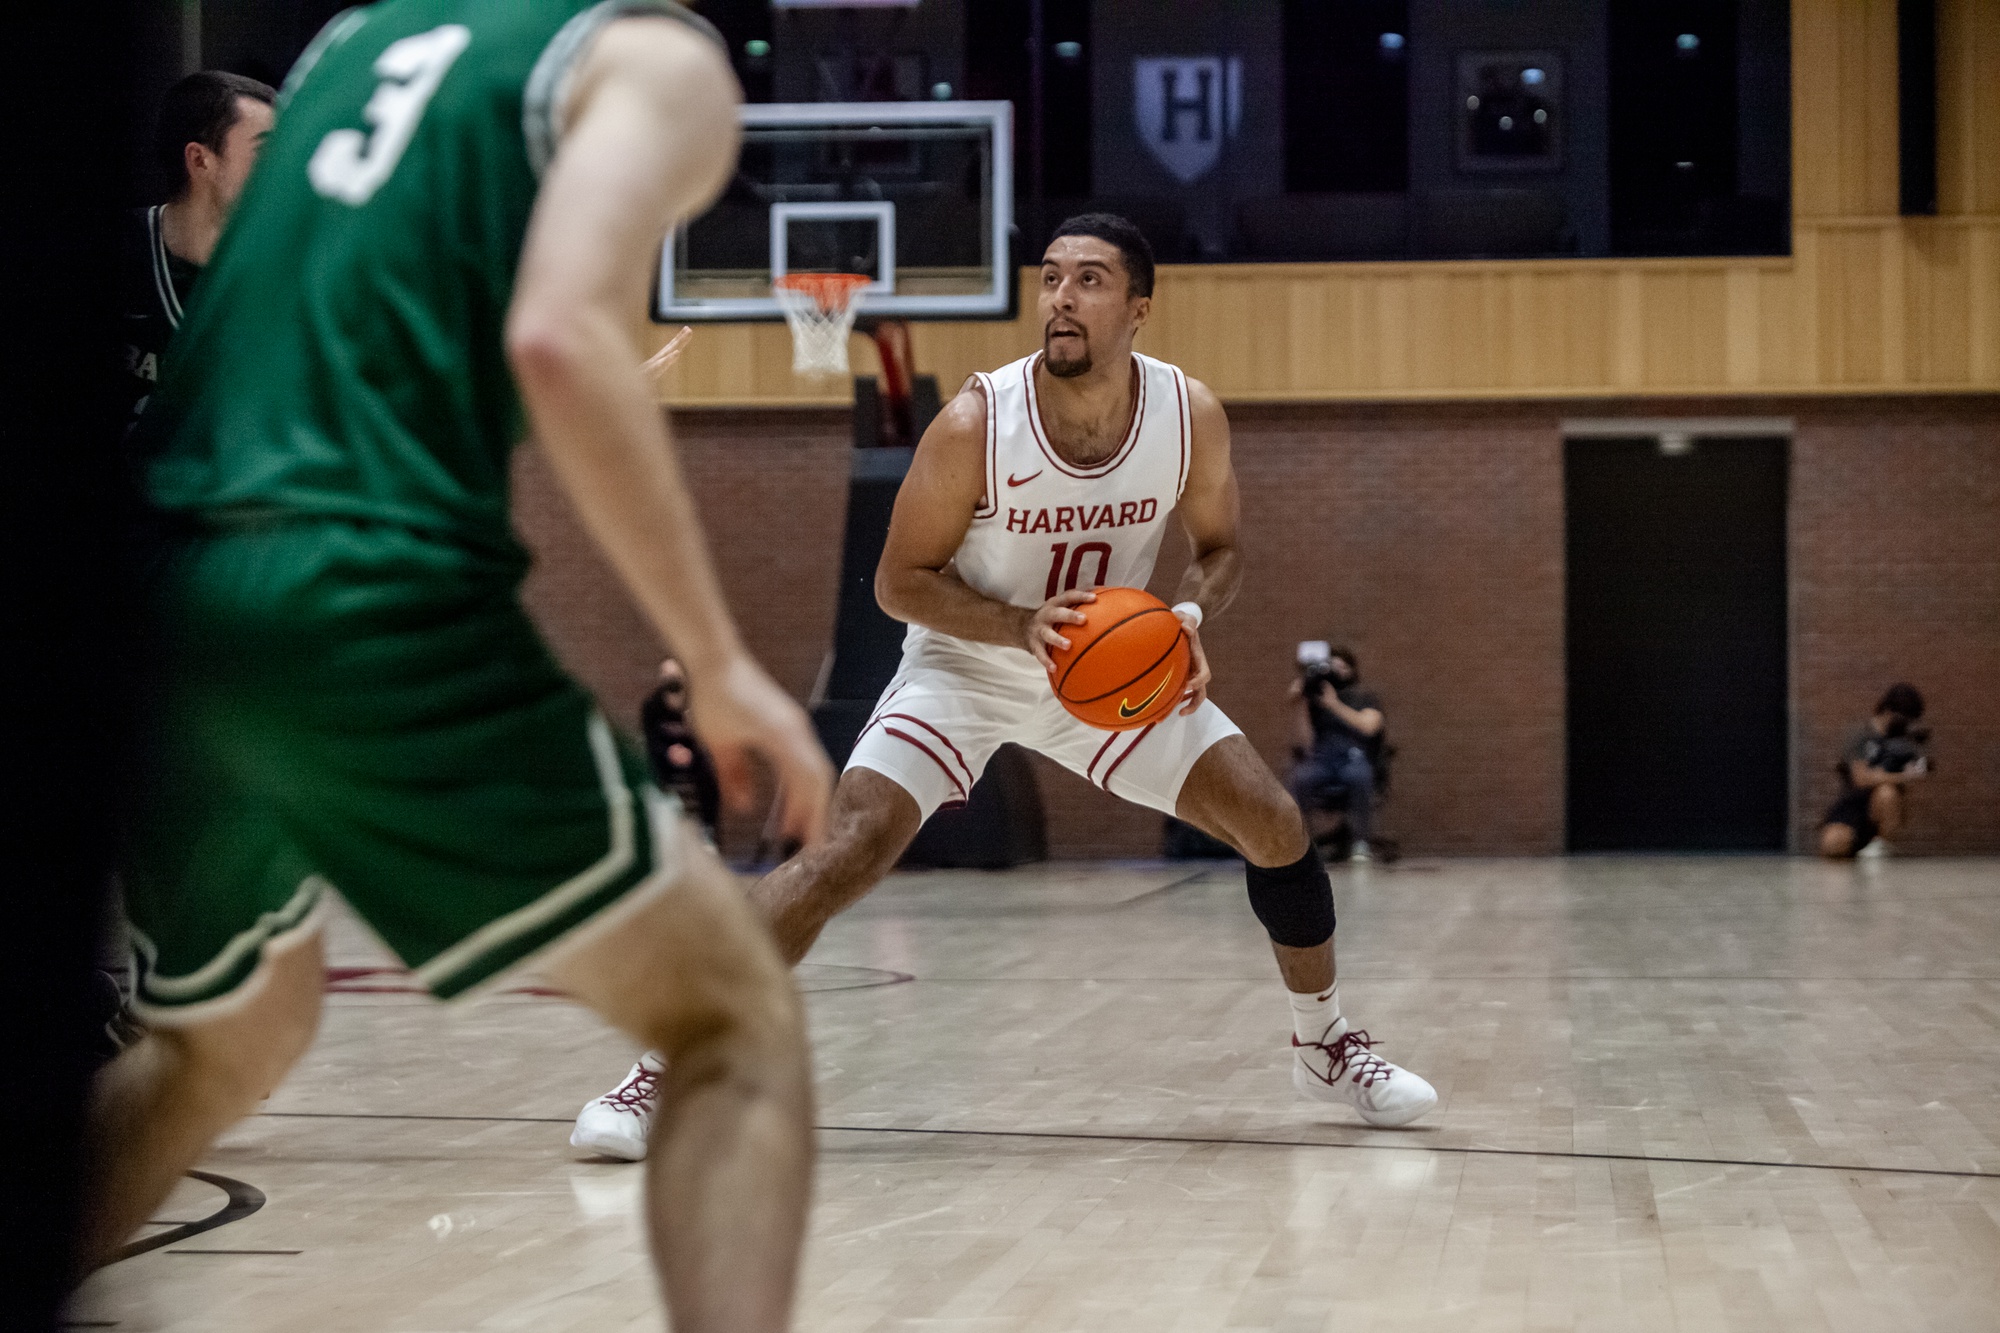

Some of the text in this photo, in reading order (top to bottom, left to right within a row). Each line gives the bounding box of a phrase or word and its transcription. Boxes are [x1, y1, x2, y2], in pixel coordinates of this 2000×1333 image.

[307, 23, 472, 207] 3
[1160, 67, 1213, 142] H
[1006, 498, 1158, 534] HARVARD
[1045, 541, 1112, 602] 10
